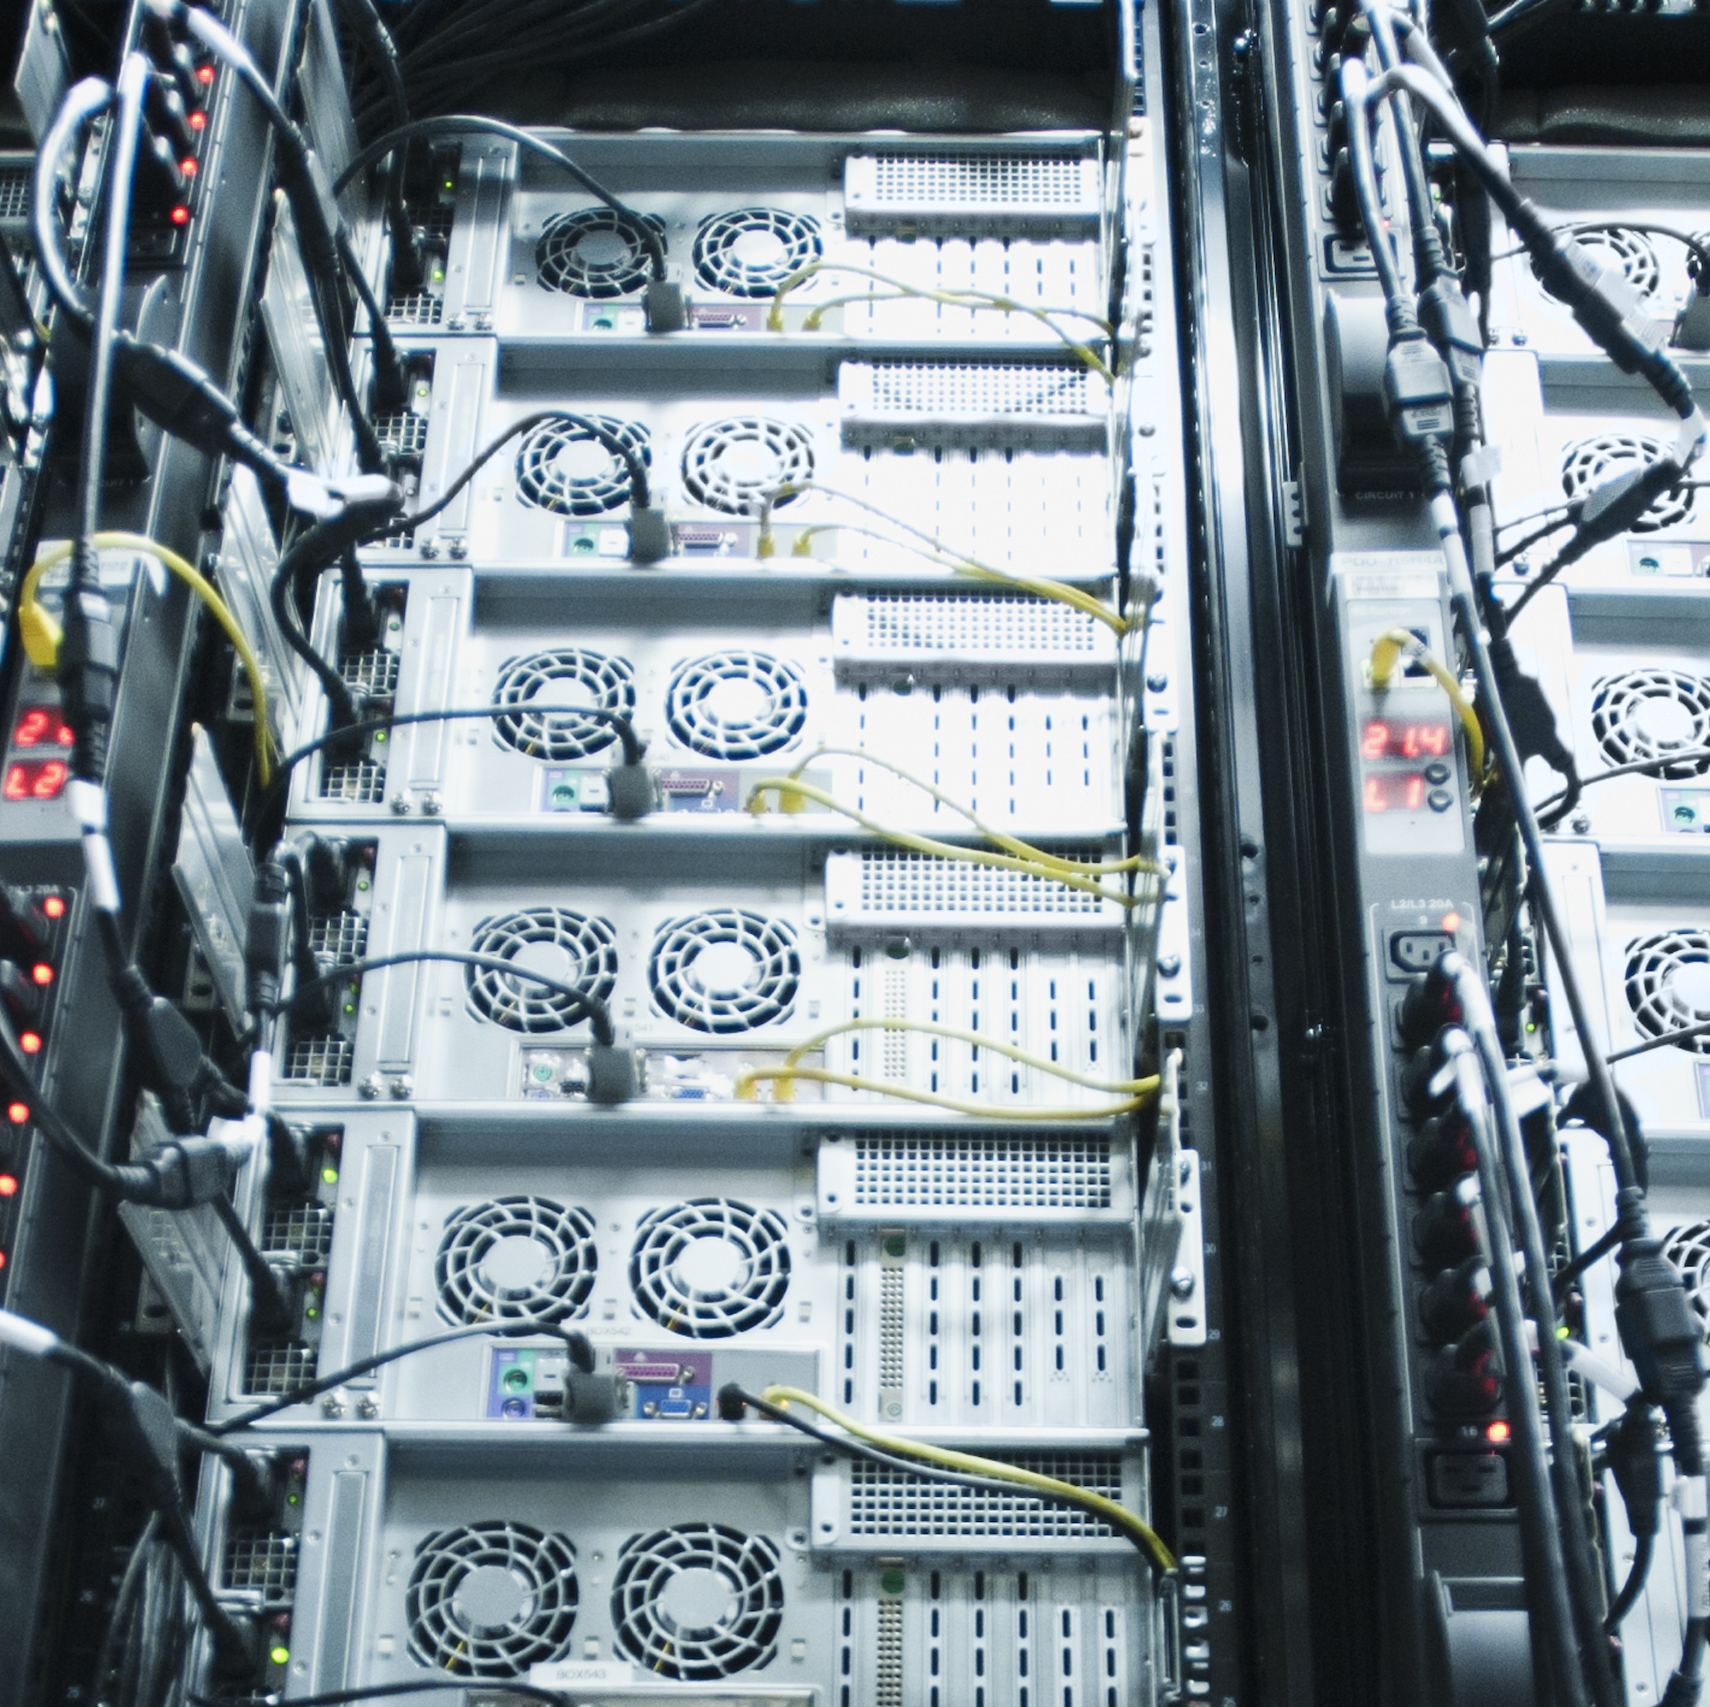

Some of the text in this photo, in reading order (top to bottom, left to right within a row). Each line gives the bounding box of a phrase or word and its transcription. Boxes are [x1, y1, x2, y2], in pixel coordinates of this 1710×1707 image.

[1390, 898, 1454, 910] L2/L3 20A
[1215, 1505, 1228, 1518] 27
